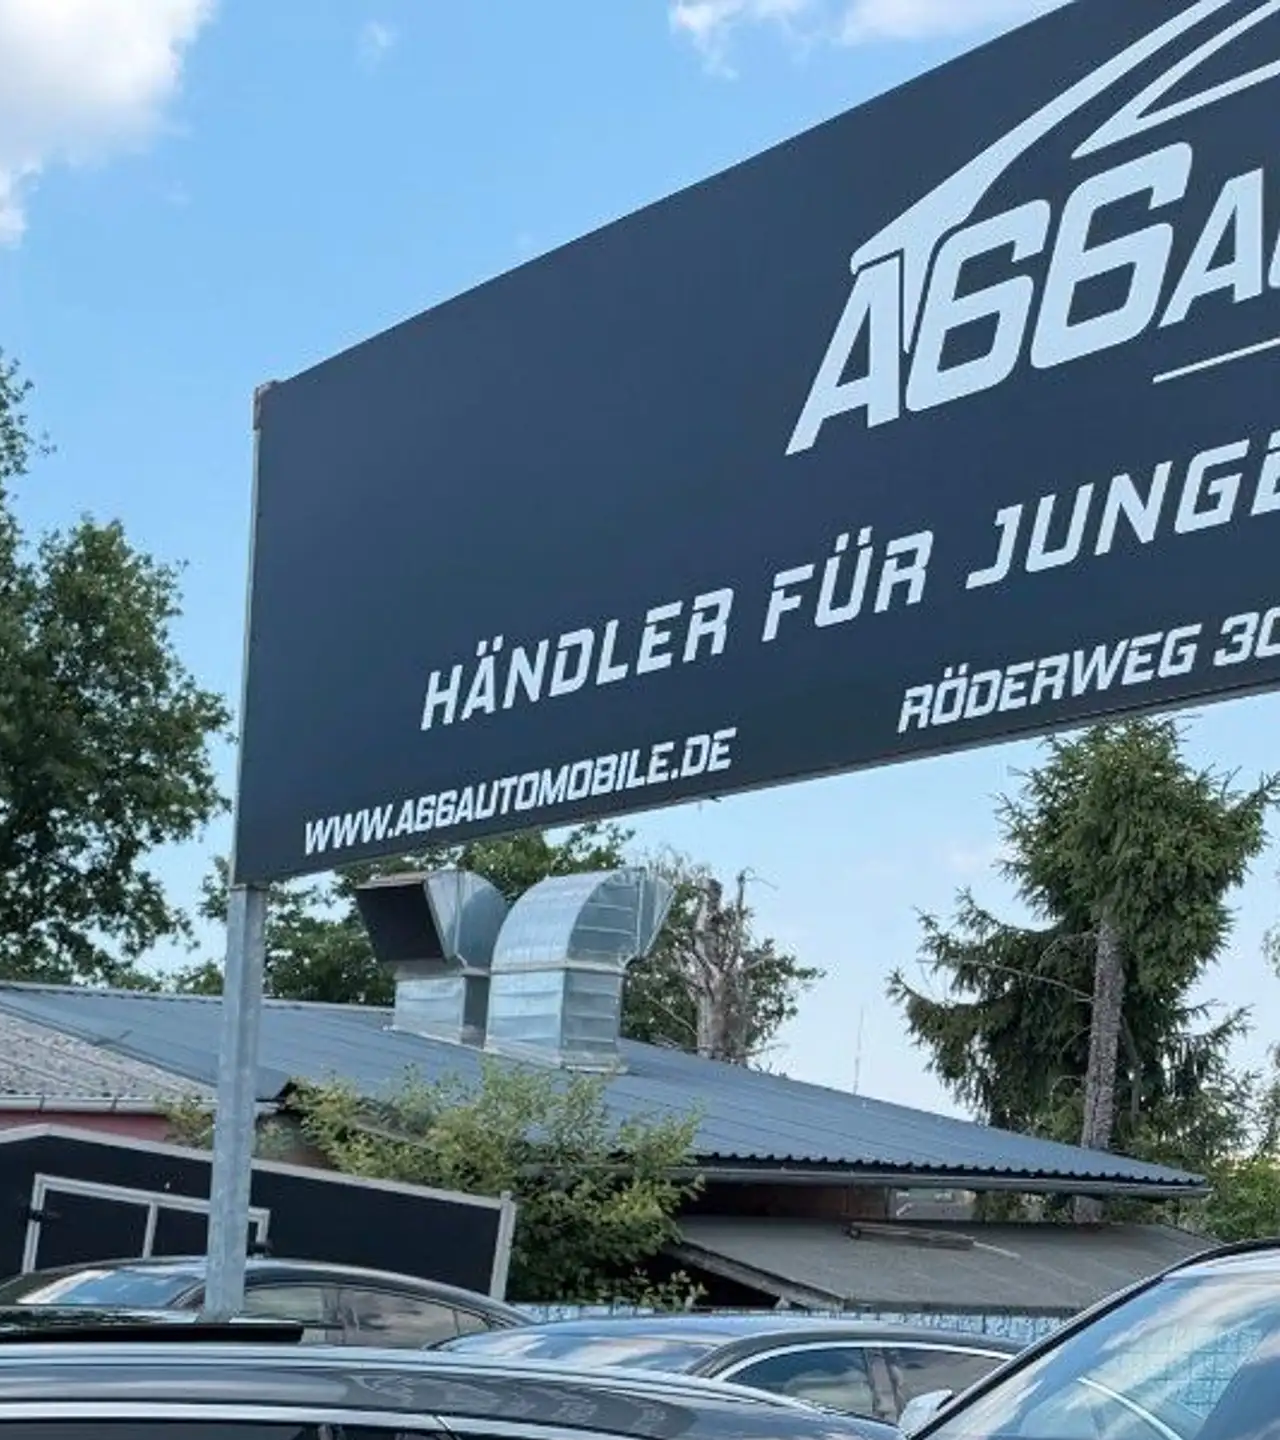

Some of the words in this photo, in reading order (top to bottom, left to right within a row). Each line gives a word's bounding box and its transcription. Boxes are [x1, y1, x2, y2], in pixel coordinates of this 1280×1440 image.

[420, 587, 734, 731] HÄNDLER
[761, 526, 934, 642] FÜR
[896, 623, 1202, 734] RÖDERWEG
[304, 727, 737, 855] WWW.A66AUTOMOBILE.DE
